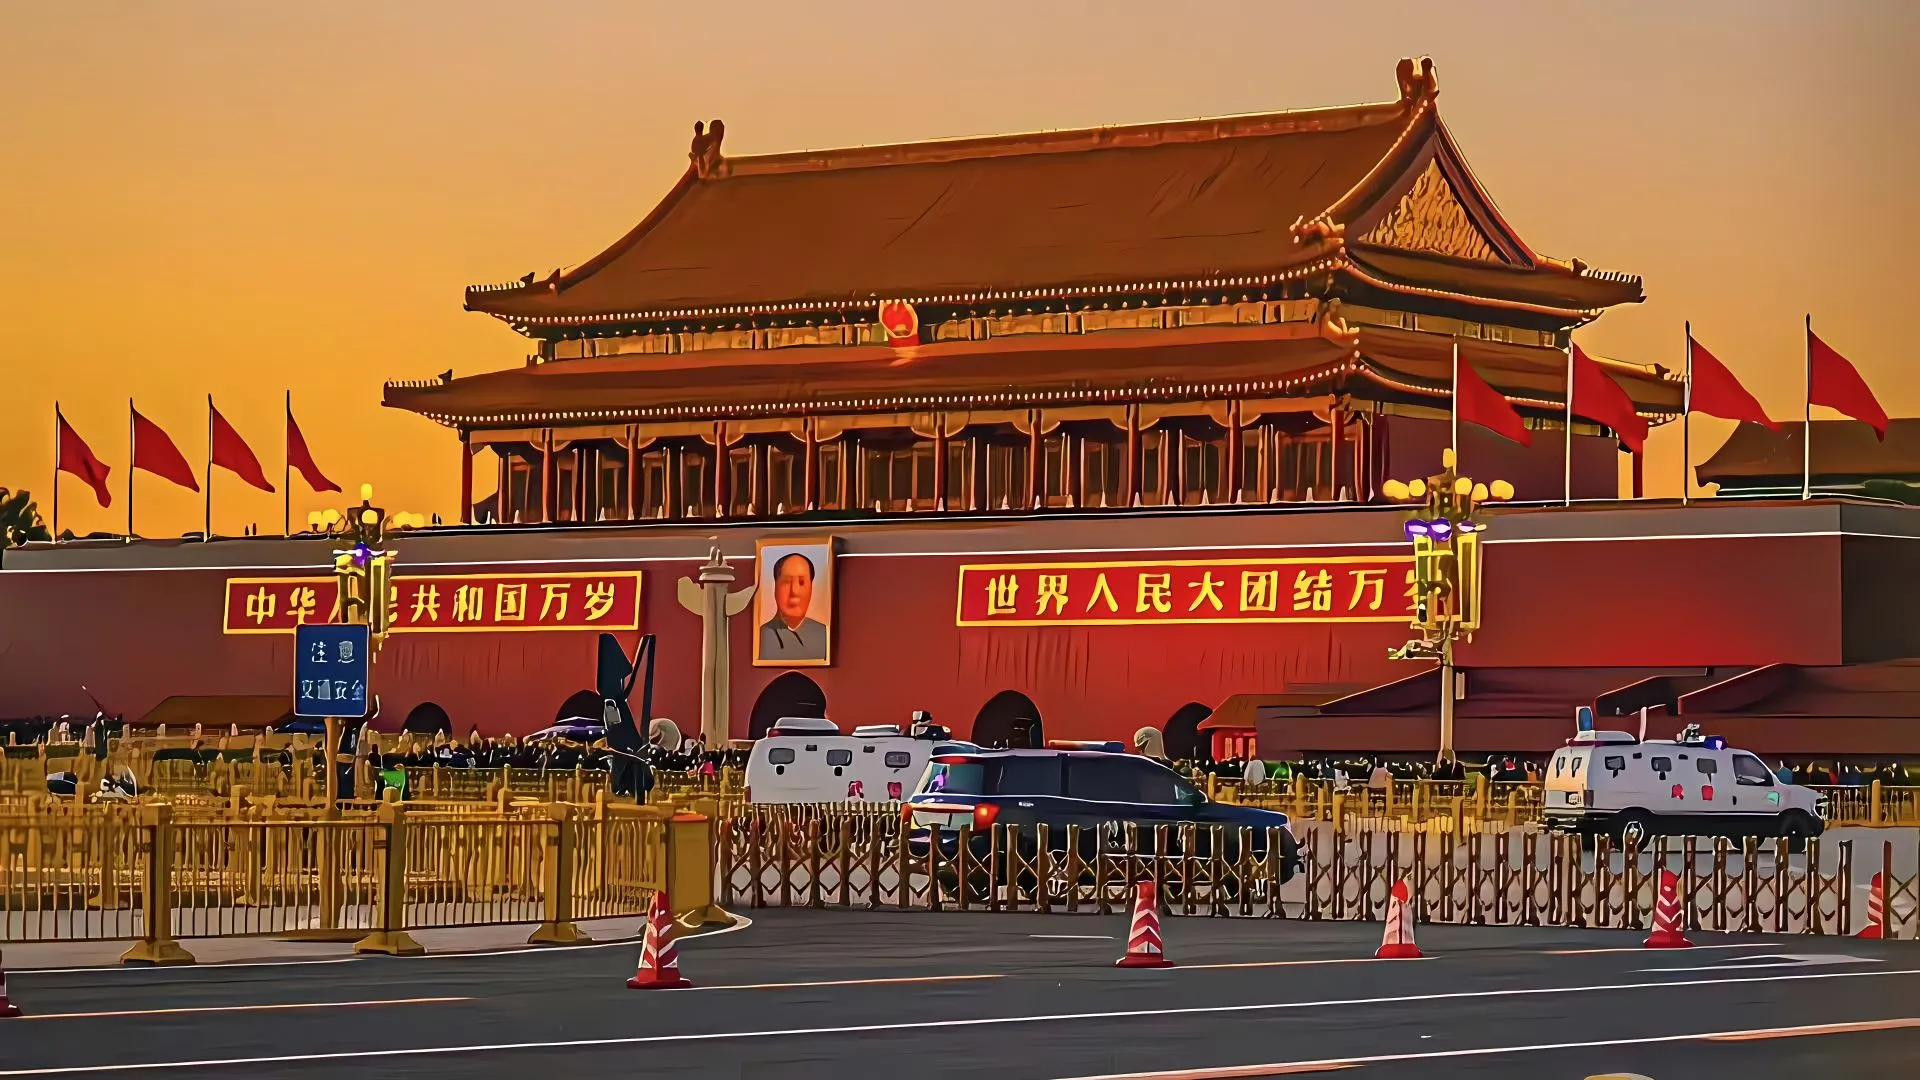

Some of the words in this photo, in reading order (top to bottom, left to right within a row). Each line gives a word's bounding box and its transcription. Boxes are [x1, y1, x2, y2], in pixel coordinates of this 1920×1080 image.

[245, 582, 616, 624] 中华共和国万岁
